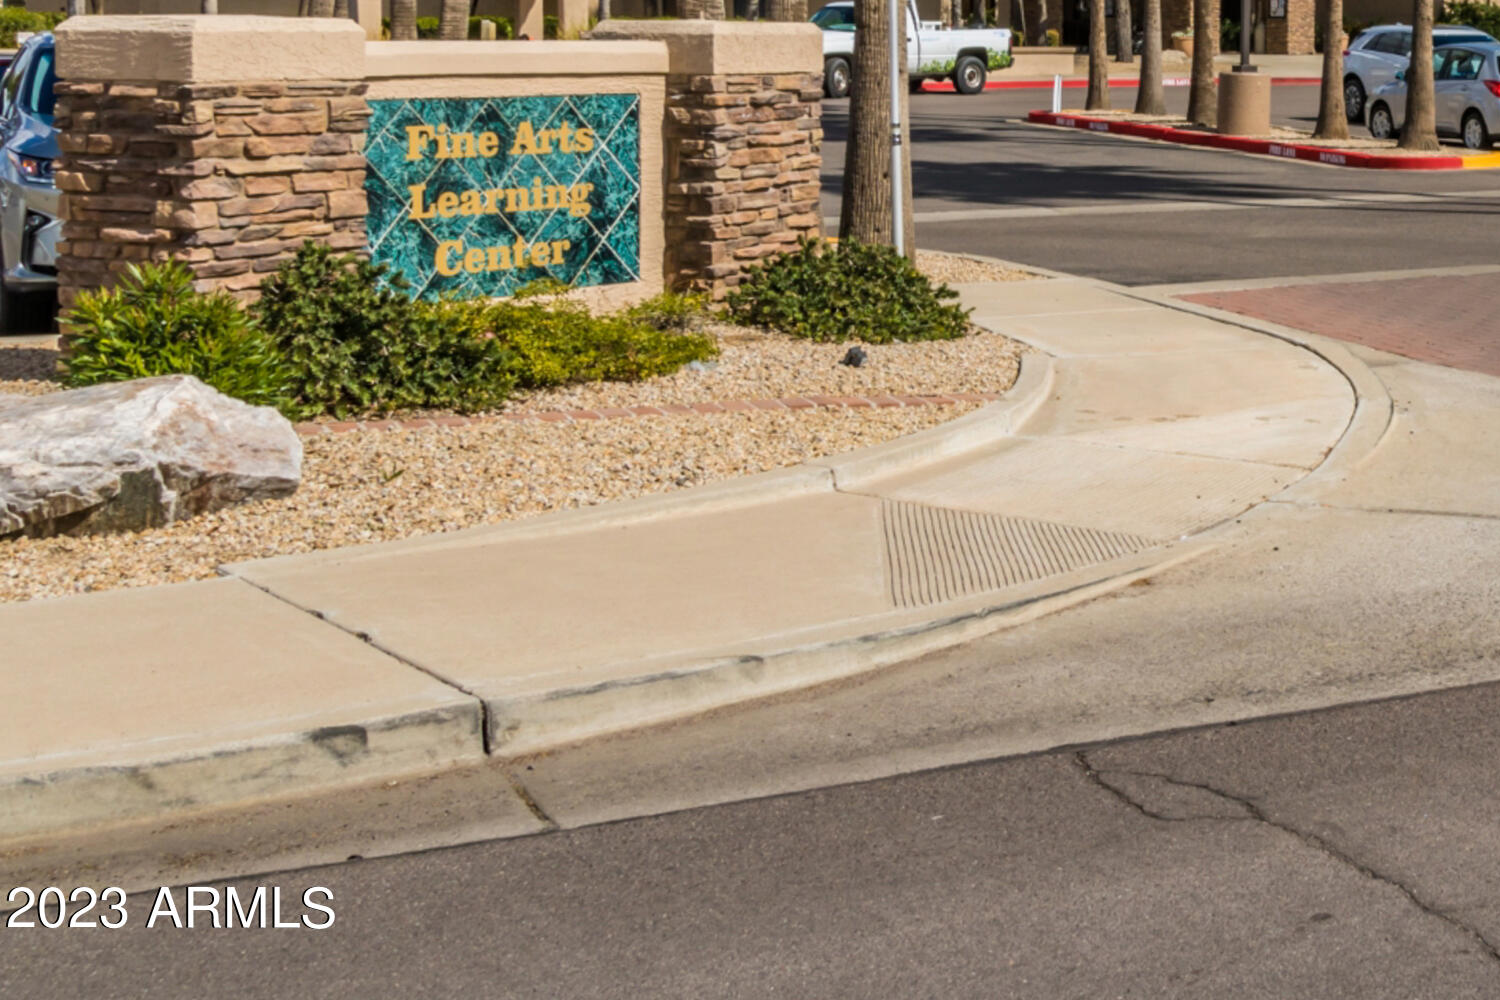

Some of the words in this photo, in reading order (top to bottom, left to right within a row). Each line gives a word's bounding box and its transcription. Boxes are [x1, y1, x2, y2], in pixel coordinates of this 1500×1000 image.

[405, 122, 500, 161] Fine
[509, 120, 595, 155] Arts
[407, 176, 595, 220] Learning
[434, 236, 572, 277] Center
